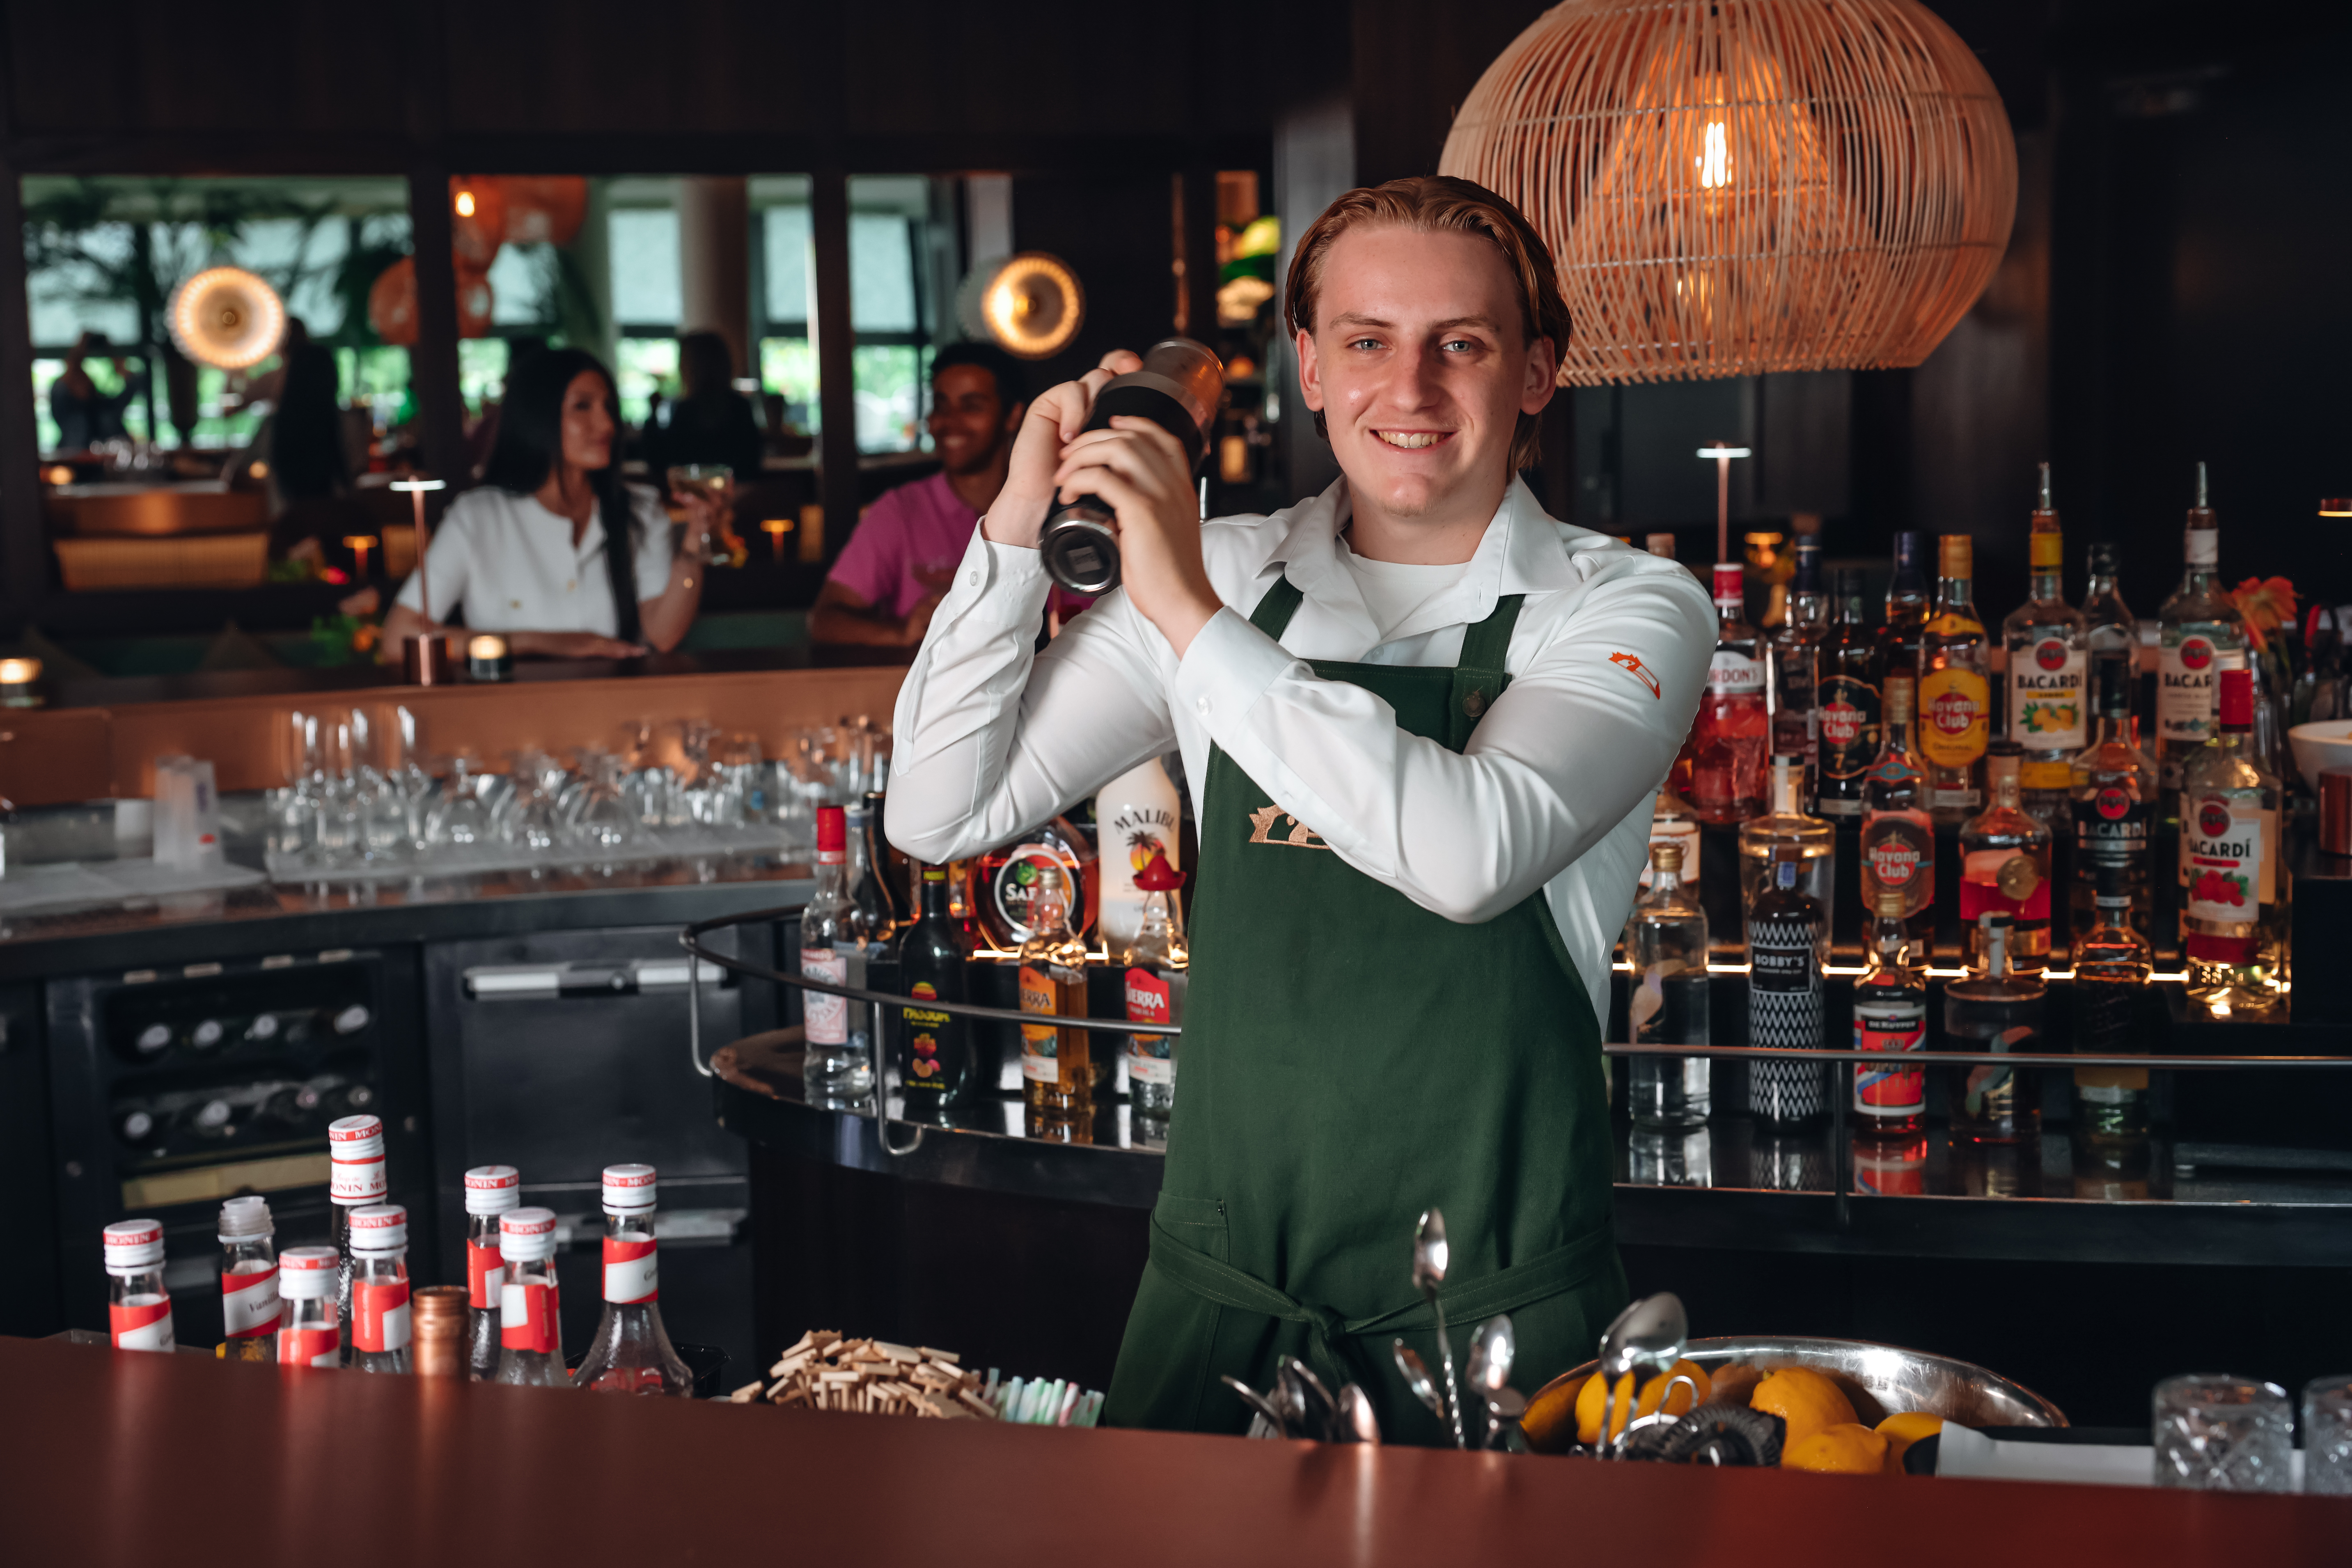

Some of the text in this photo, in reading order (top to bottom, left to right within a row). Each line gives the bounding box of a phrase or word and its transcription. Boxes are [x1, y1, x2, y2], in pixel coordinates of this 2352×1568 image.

[1936, 713, 1969, 728] Club
[1869, 846, 1921, 864] Havana
[1877, 861, 1910, 878] Club
